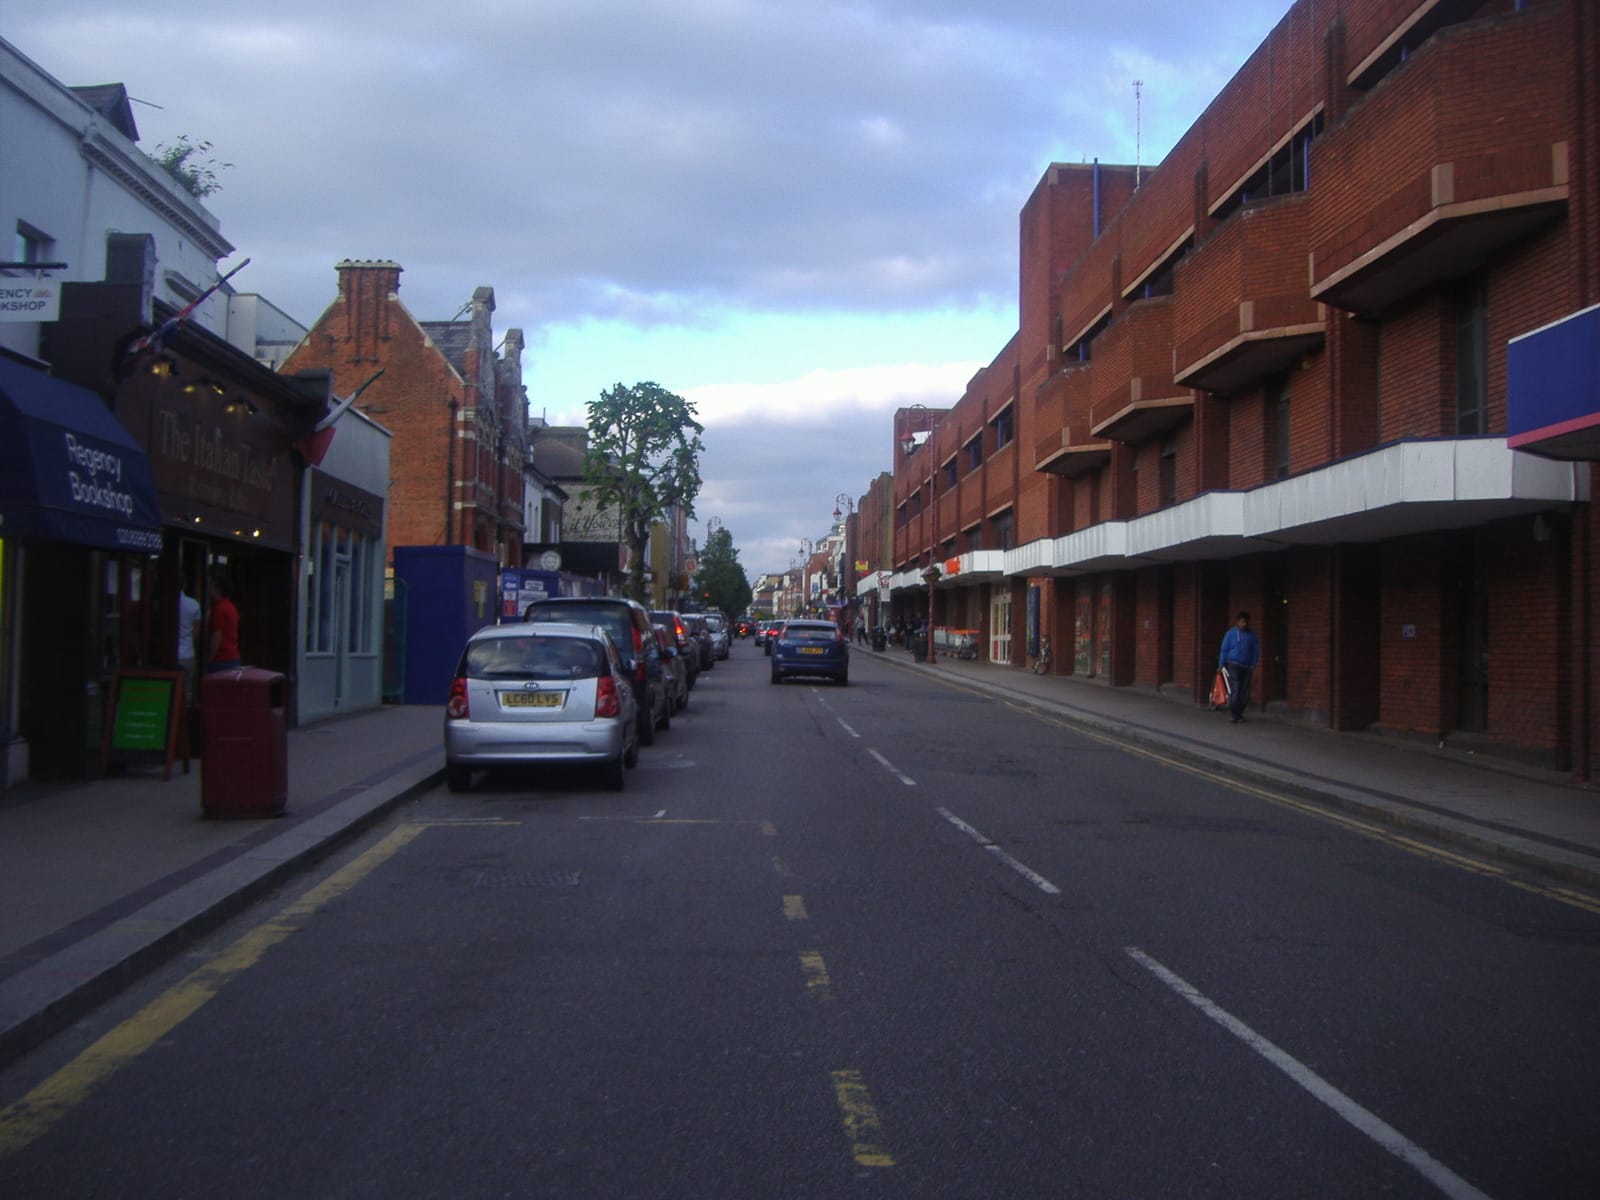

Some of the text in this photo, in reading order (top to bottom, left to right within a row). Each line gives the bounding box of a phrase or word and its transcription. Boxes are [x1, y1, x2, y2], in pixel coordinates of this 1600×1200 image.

[64, 431, 121, 483] Regency
[160, 409, 190, 462] The
[194, 423, 239, 480] Italian
[68, 470, 133, 520] Bookshop
